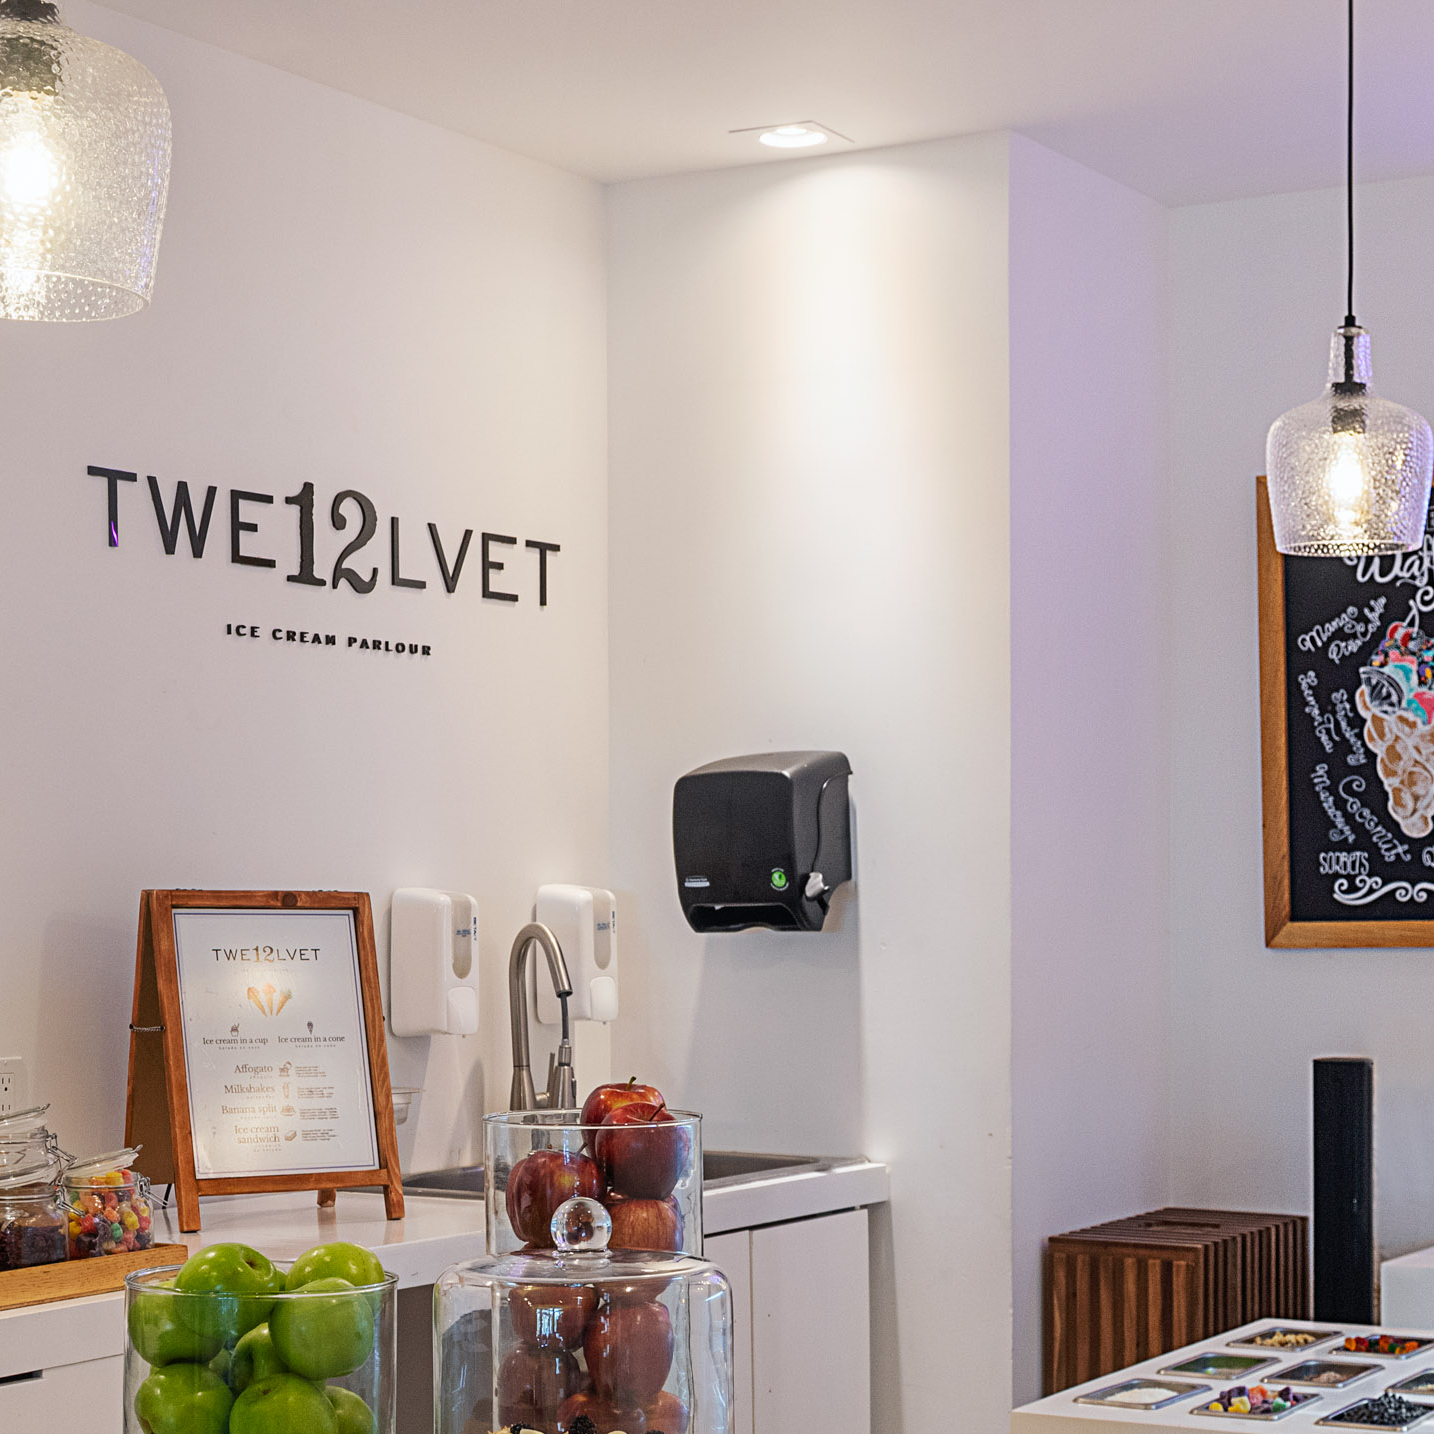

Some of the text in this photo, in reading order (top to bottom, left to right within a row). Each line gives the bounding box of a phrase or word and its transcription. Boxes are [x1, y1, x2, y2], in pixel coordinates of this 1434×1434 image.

[87, 465, 561, 607] TWE12LVET
[1297, 605, 1359, 652] Mango
[226, 623, 432, 657] ICE CREAM PARLOUR
[1338, 775, 1412, 862] Coconut
[211, 945, 320, 963] TWE12LVET
[202, 1037, 214, 1045] Ice
[254, 1037, 269, 1046] cup
[314, 1035, 322, 1043] in
[234, 1063, 273, 1074] Affogato
[224, 1083, 275, 1094] Milkshakes
[221, 1104, 277, 1115] Banana split
[234, 1125, 279, 1134] Ice cream
[238, 1133, 280, 1144] sandwich
